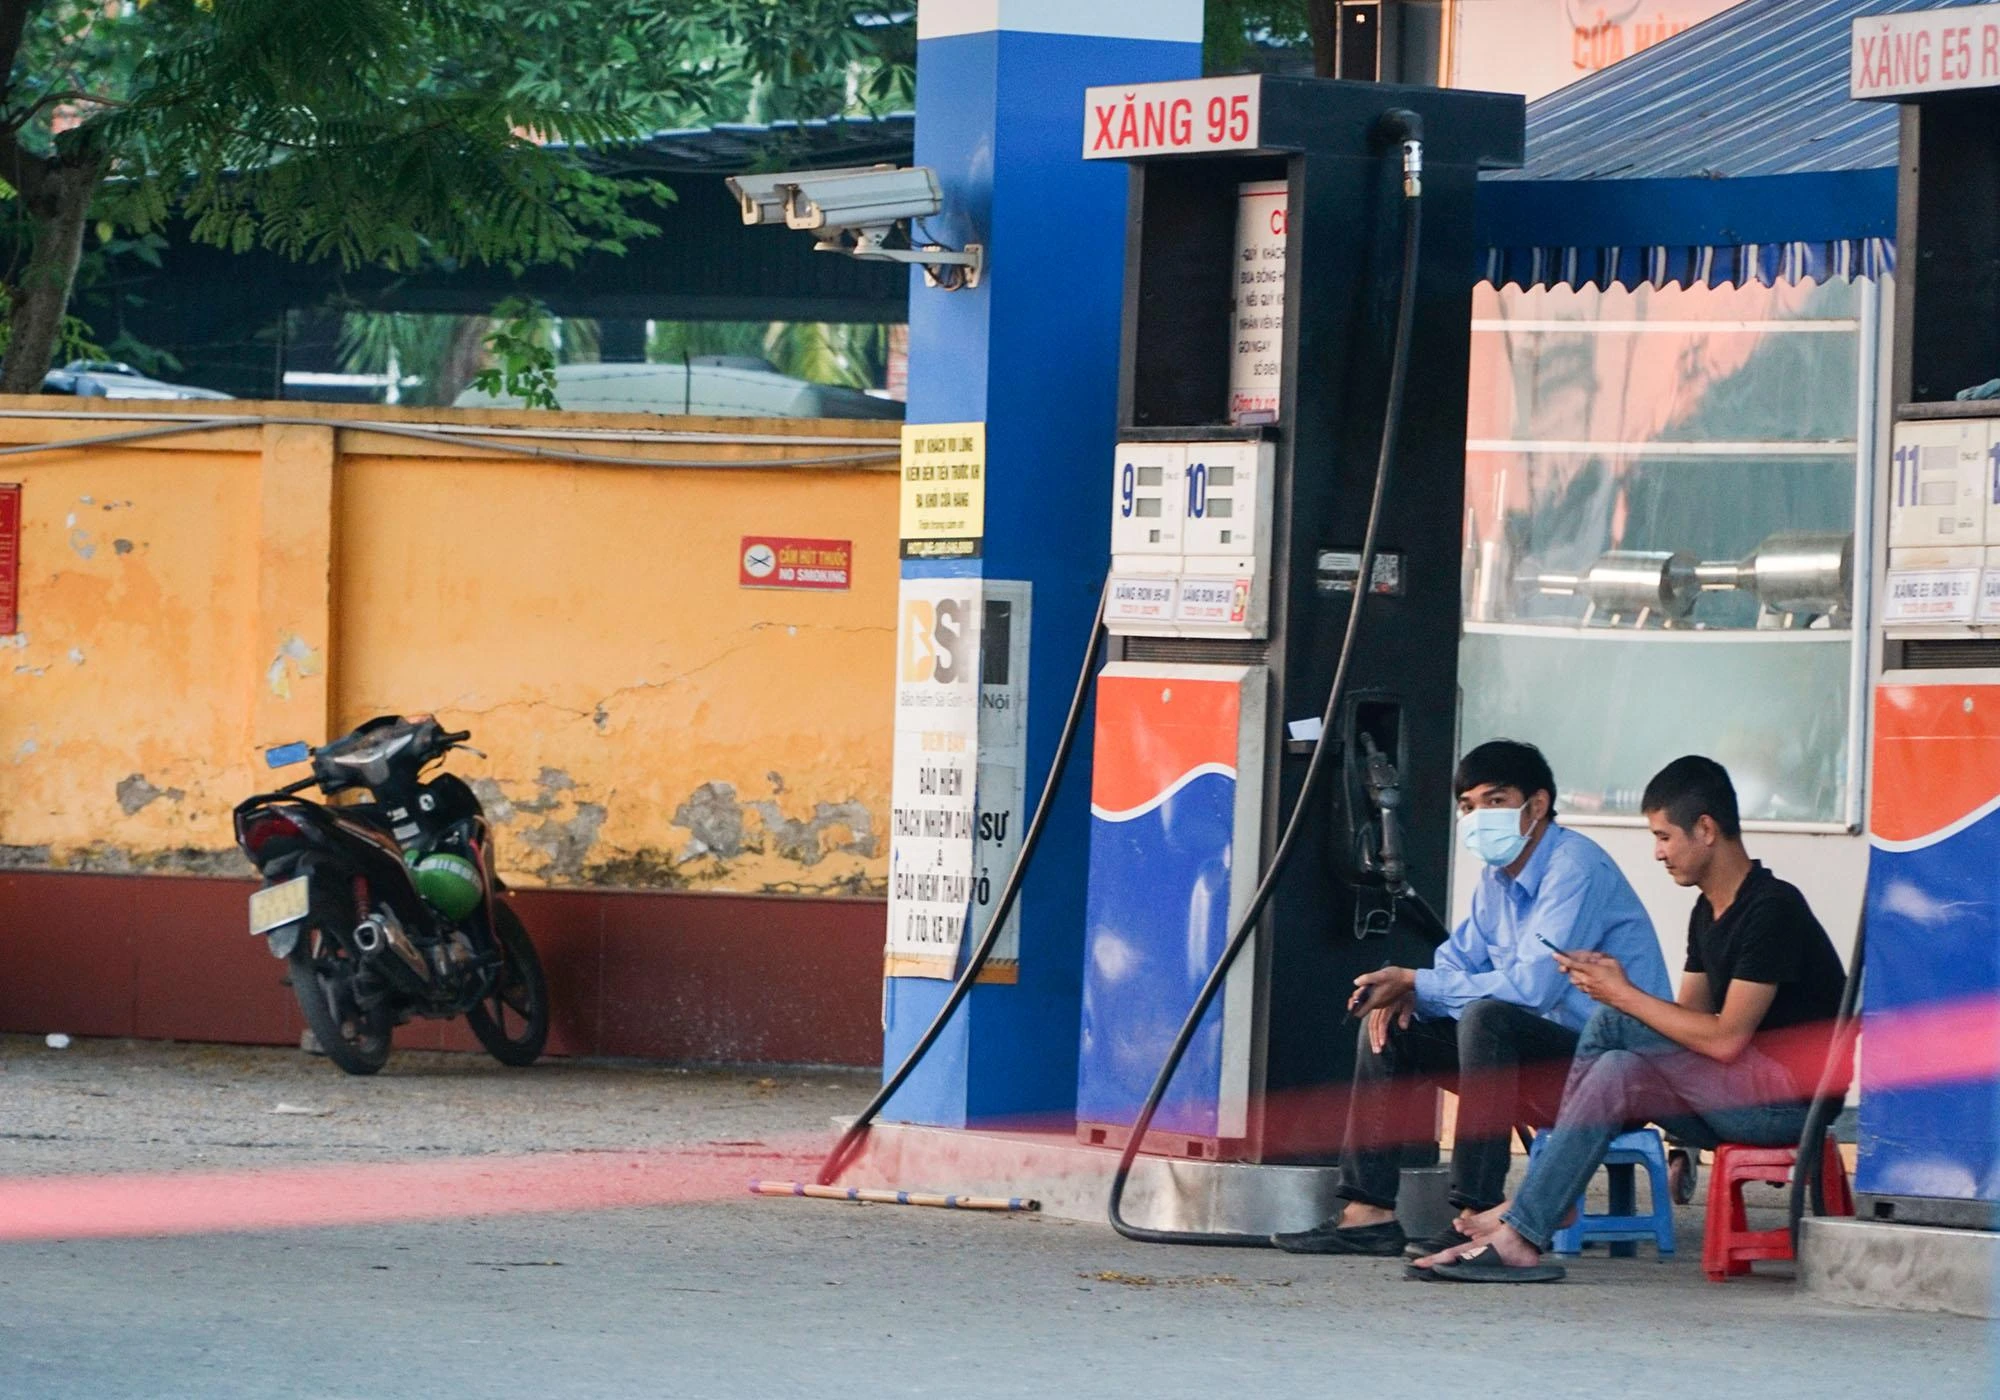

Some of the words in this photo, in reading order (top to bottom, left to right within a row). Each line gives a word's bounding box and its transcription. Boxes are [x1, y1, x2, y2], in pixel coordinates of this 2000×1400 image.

[1858, 23, 1931, 89] XĂNG
[1942, 27, 1971, 80] E5
[1093, 92, 1192, 150] XĂNG
[1207, 95, 1250, 144] 95
[1122, 463, 1134, 518] 9
[1186, 463, 1206, 518] 10
[1894, 445, 1920, 507] 11
[779, 567, 795, 581] NO
[796, 568, 847, 584] SMOKING
[1114, 583, 1136, 600] XĂNG
[1137, 587, 1152, 601] RON
[1182, 585, 1201, 602] XĂNG
[1202, 588, 1214, 602] RON
[1893, 579, 1919, 598] XĂNG
[982, 692, 1010, 712] Nội
[920, 758, 937, 796] BẢO
[940, 757, 963, 797] HIỂM
[894, 803, 922, 837] TRÁCH
[923, 804, 952, 843] NHIỆM
[979, 810, 1010, 847] SỰ
[896, 863, 915, 900] BẢO
[917, 862, 939, 901] HIỂM
[932, 916, 943, 943] XE
